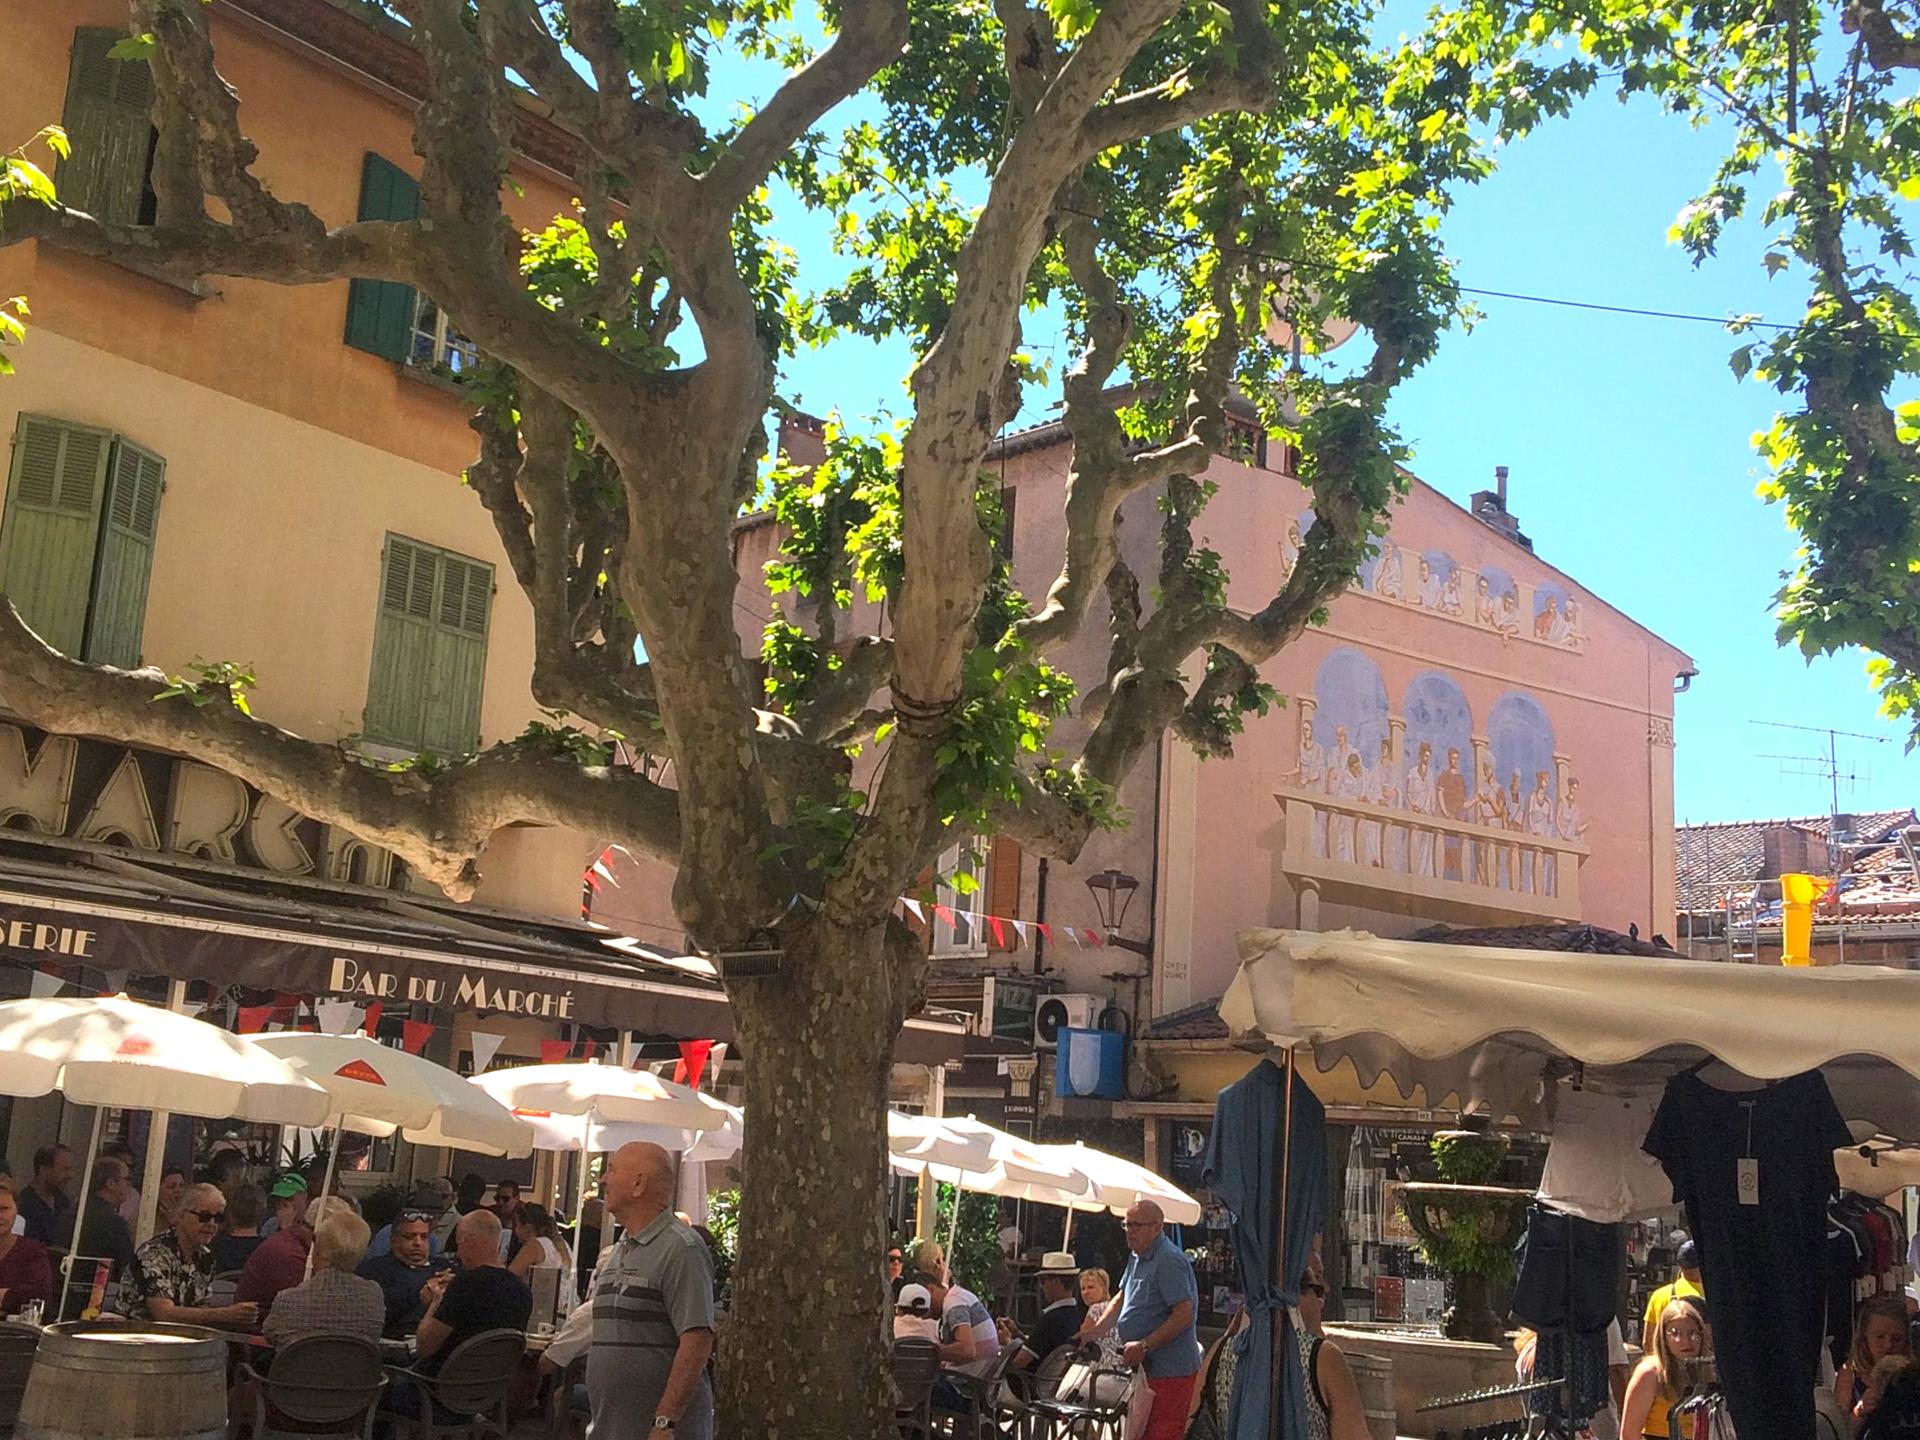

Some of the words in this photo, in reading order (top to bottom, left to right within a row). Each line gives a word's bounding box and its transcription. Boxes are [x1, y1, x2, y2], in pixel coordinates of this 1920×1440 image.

[329, 957, 398, 999] BAR
[408, 976, 446, 1004] DU
[452, 973, 575, 1020] MARCHÉ
